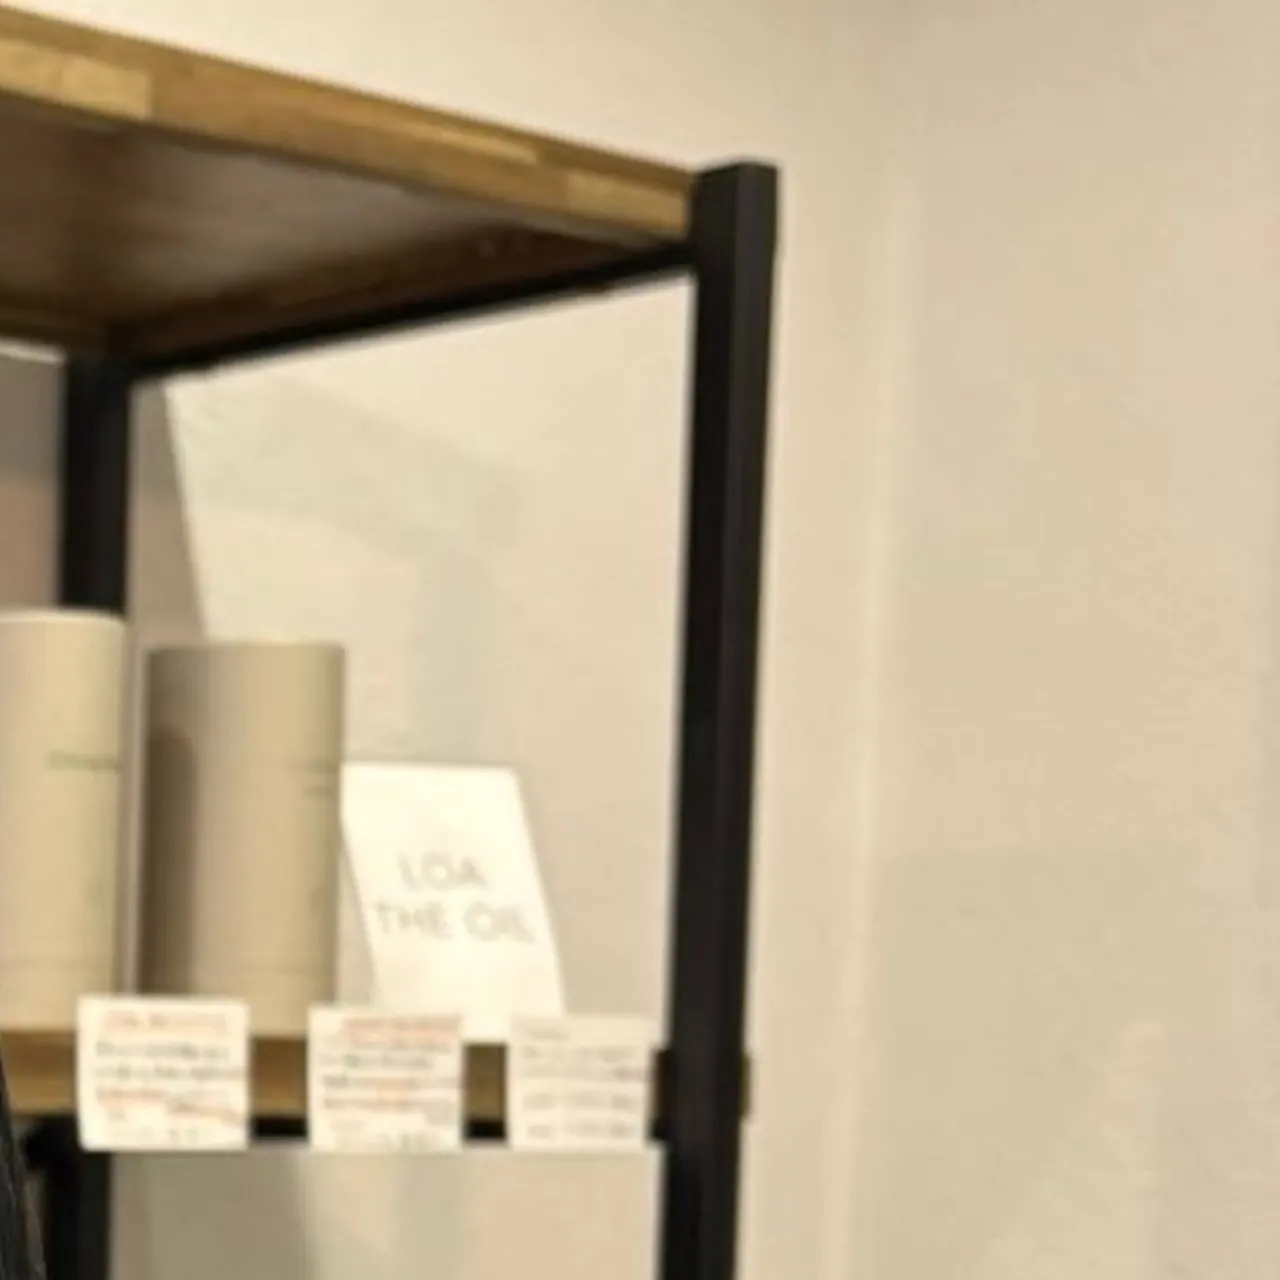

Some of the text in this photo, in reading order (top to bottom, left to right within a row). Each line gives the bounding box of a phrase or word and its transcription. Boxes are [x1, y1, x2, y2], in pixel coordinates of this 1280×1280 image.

[396, 850, 489, 893] LOA
[376, 898, 537, 943] THE OIL
